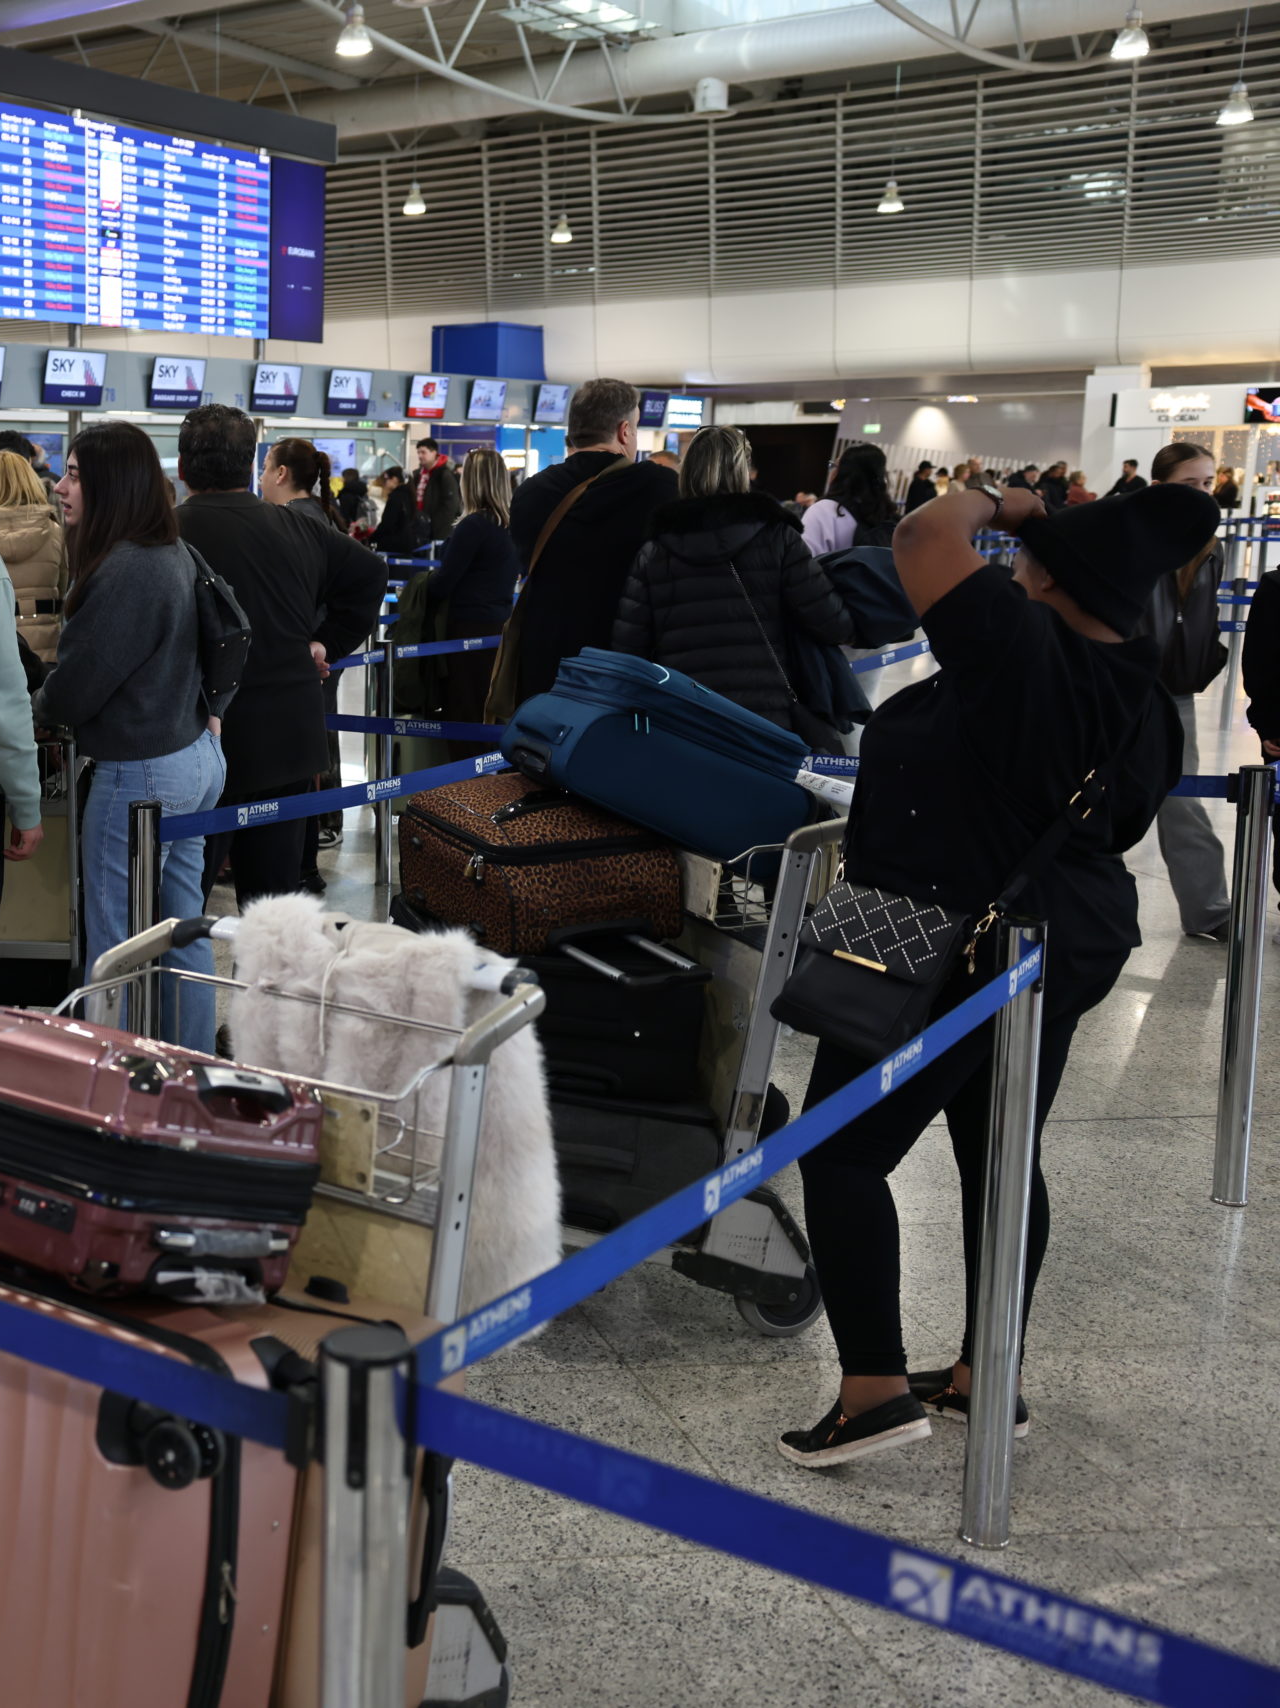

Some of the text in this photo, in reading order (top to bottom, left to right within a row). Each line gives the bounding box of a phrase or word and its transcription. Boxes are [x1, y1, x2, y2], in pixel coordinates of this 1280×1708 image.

[52, 358, 75, 372] SKY
[158, 365, 179, 378] SKY
[259, 371, 277, 383] SKY
[333, 376, 351, 388] SKY
[61, 390, 79, 398] CHECK
[407, 721, 442, 730] ATHENS
[483, 752, 504, 763] ATHEN
[814, 756, 860, 766] ATHENS
[376, 778, 401, 790] ATHENS
[249, 802, 279, 815] ATHENS
[1018, 949, 1040, 976] ATHENS
[893, 1037, 923, 1070] ATHENS
[720, 1147, 764, 1188] ATHENS
[468, 1286, 532, 1341] ATHENS
[958, 1576, 1163, 1666] ATHENS
